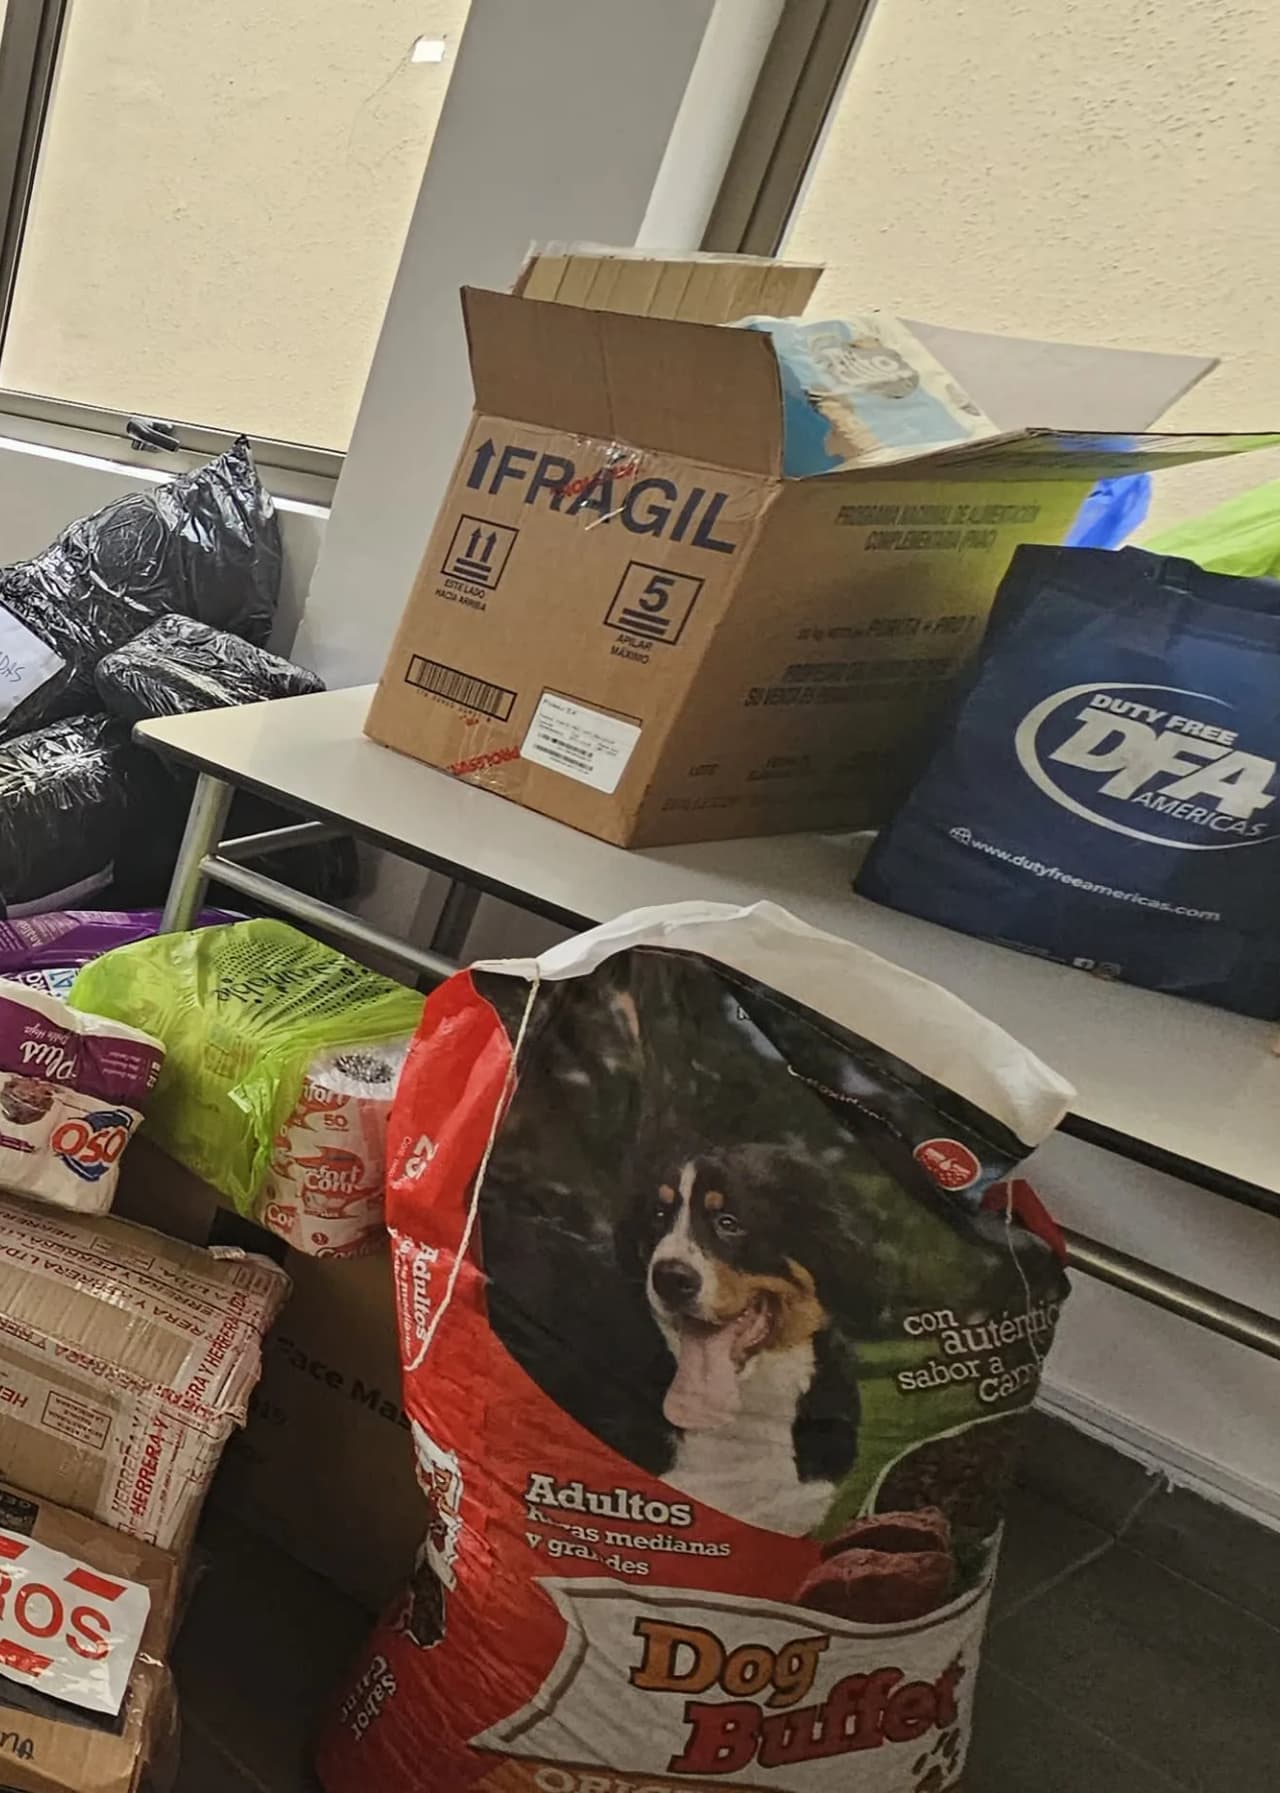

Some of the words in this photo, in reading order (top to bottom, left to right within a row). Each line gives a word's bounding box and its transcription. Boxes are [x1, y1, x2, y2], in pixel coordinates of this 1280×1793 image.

[490, 446, 737, 554] FRAGIL
[639, 575, 676, 612] 5
[615, 633, 653, 651] APILAR
[1090, 694, 1167, 722] DUTY
[1166, 715, 1239, 746] FREE
[1048, 707, 1277, 820] DFA
[1131, 792, 1269, 836] AMERICAS
[971, 836, 1221, 921] www.dutyfreeamericas.com
[20, 1040, 78, 1081] Plus
[50, 1118, 127, 1165] OSO
[324, 1113, 349, 1128] 50
[903, 1307, 959, 1336] con
[941, 1302, 1060, 1355] auténtic
[897, 1355, 981, 1390] sabor
[988, 1354, 1004, 1375] a
[129, 1442, 160, 1518] HERRERA
[525, 1474, 694, 1528] Adultos
[604, 1529, 732, 1558] medianas
[629, 1618, 831, 1709] Dog
[667, 1652, 967, 1775] Buffet
